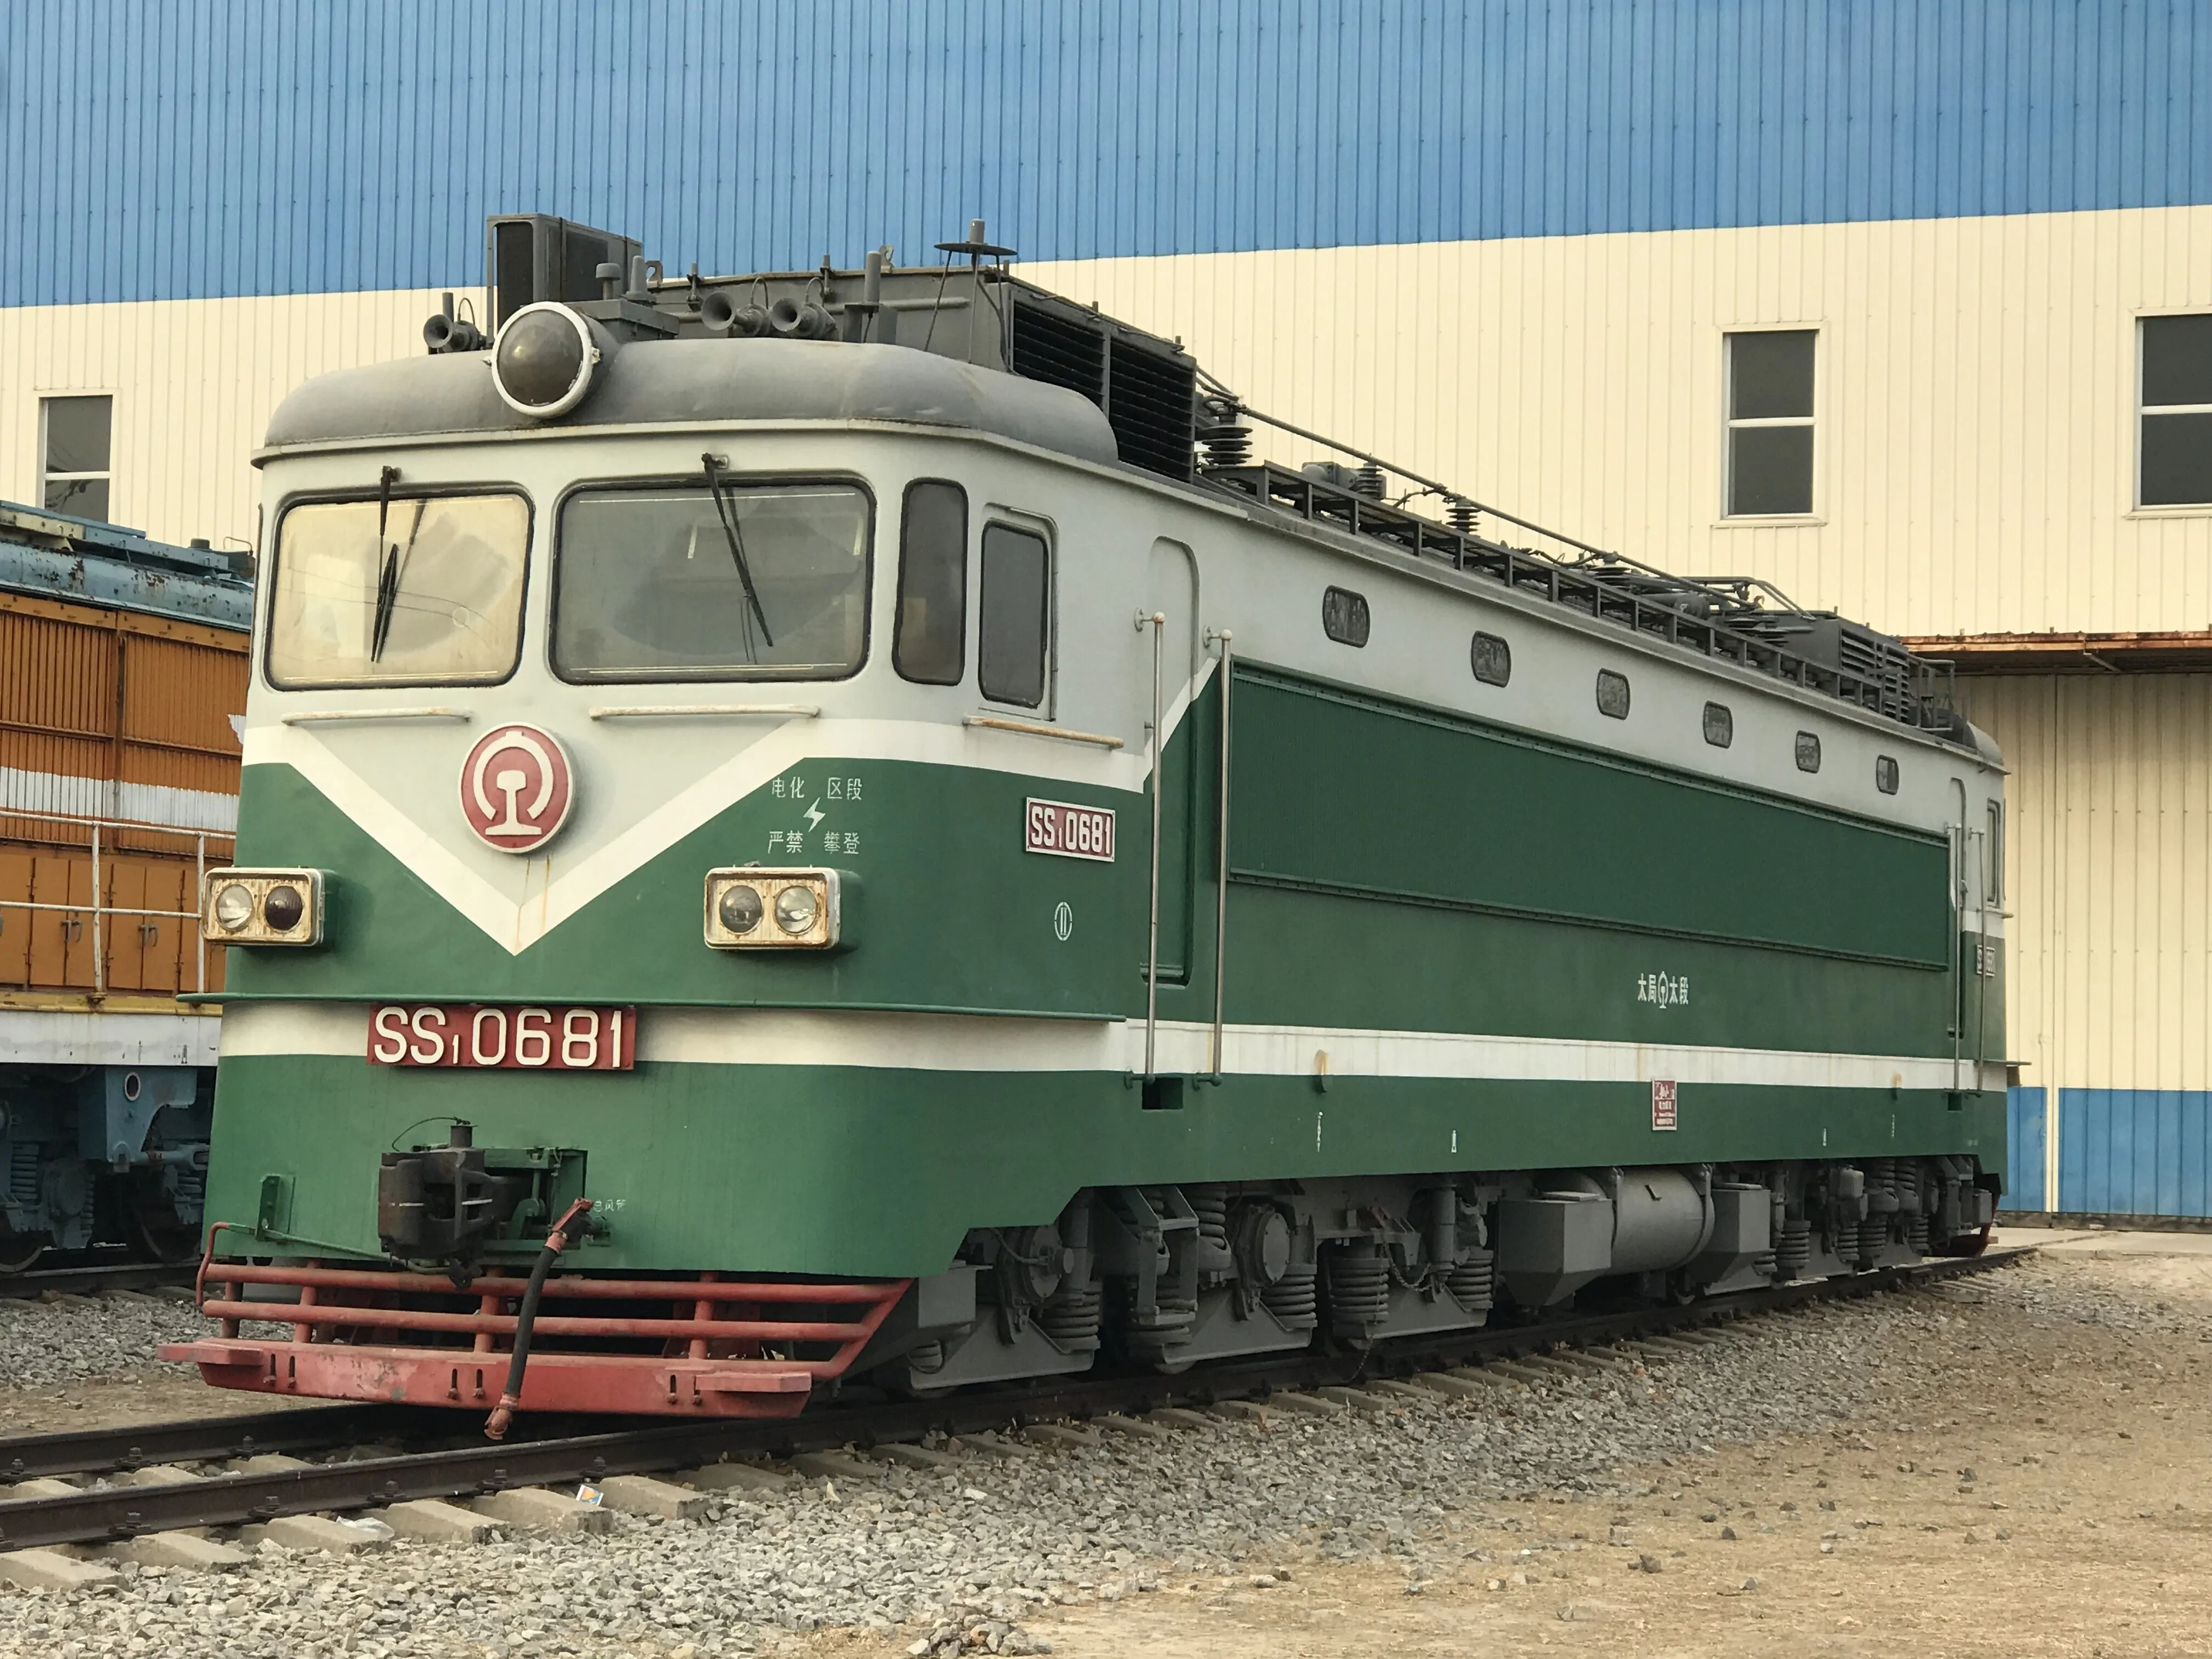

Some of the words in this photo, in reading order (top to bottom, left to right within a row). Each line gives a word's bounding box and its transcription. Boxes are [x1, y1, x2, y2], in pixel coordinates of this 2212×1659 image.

[771, 776, 805, 799] 电化
[827, 777, 862, 800] 区段
[768, 830, 803, 854] 严禁
[824, 831, 860, 854] 攀登
[1638, 973, 1657, 1003] 太局
[1669, 975, 1689, 1005] 太段
